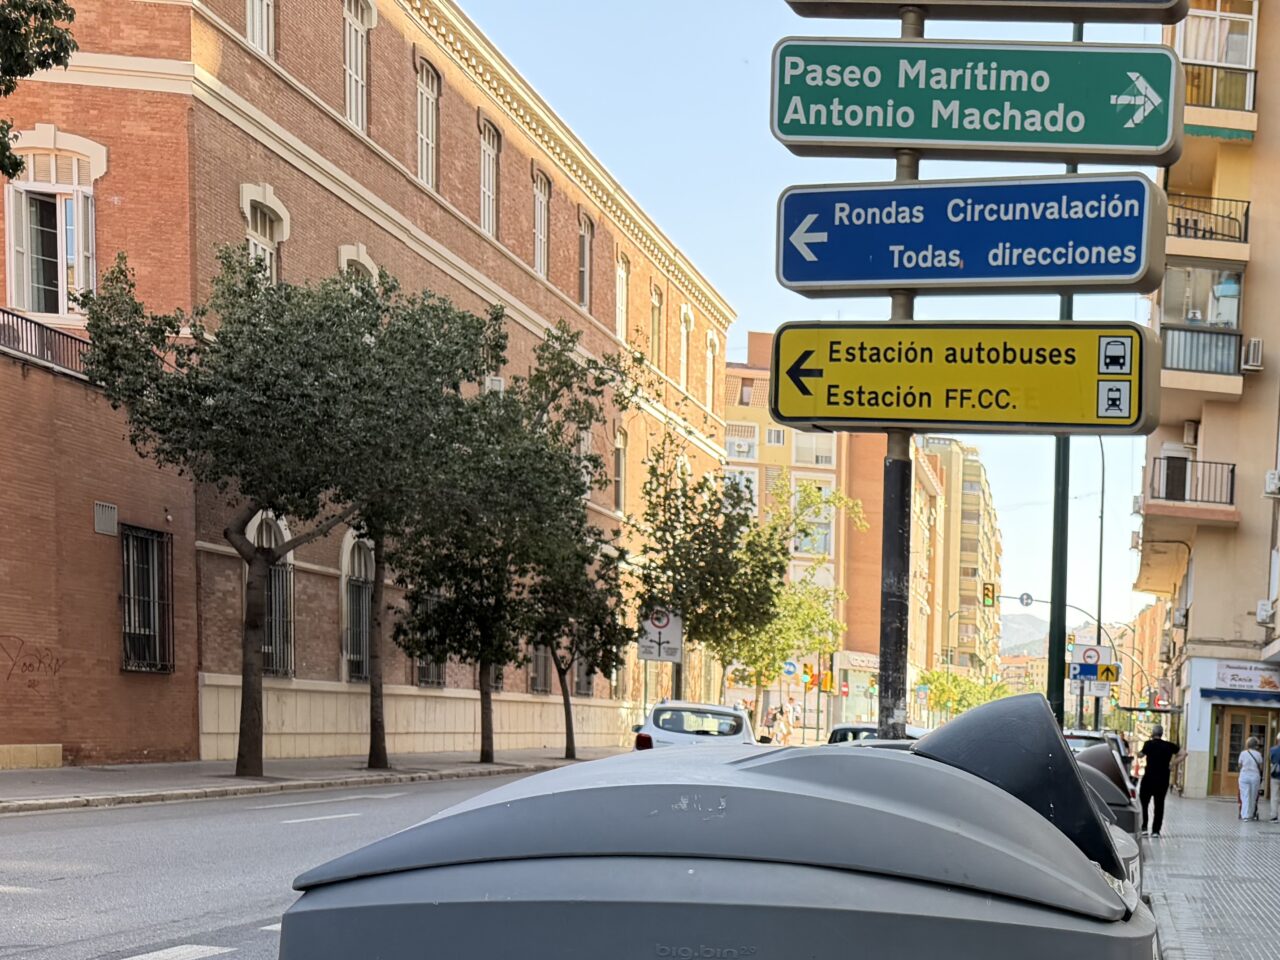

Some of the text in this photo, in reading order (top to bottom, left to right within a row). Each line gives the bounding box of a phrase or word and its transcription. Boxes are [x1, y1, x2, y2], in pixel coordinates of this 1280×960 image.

[783, 56, 1050, 93] Paseo Marítimo
[783, 96, 1086, 133] Antonio Machado
[834, 194, 1140, 226] Rondas Circunvalación
[889, 242, 1137, 269] Todas direcciones
[828, 340, 1077, 366] Estación autobuses
[826, 384, 1017, 410] Estación FF.CC.
